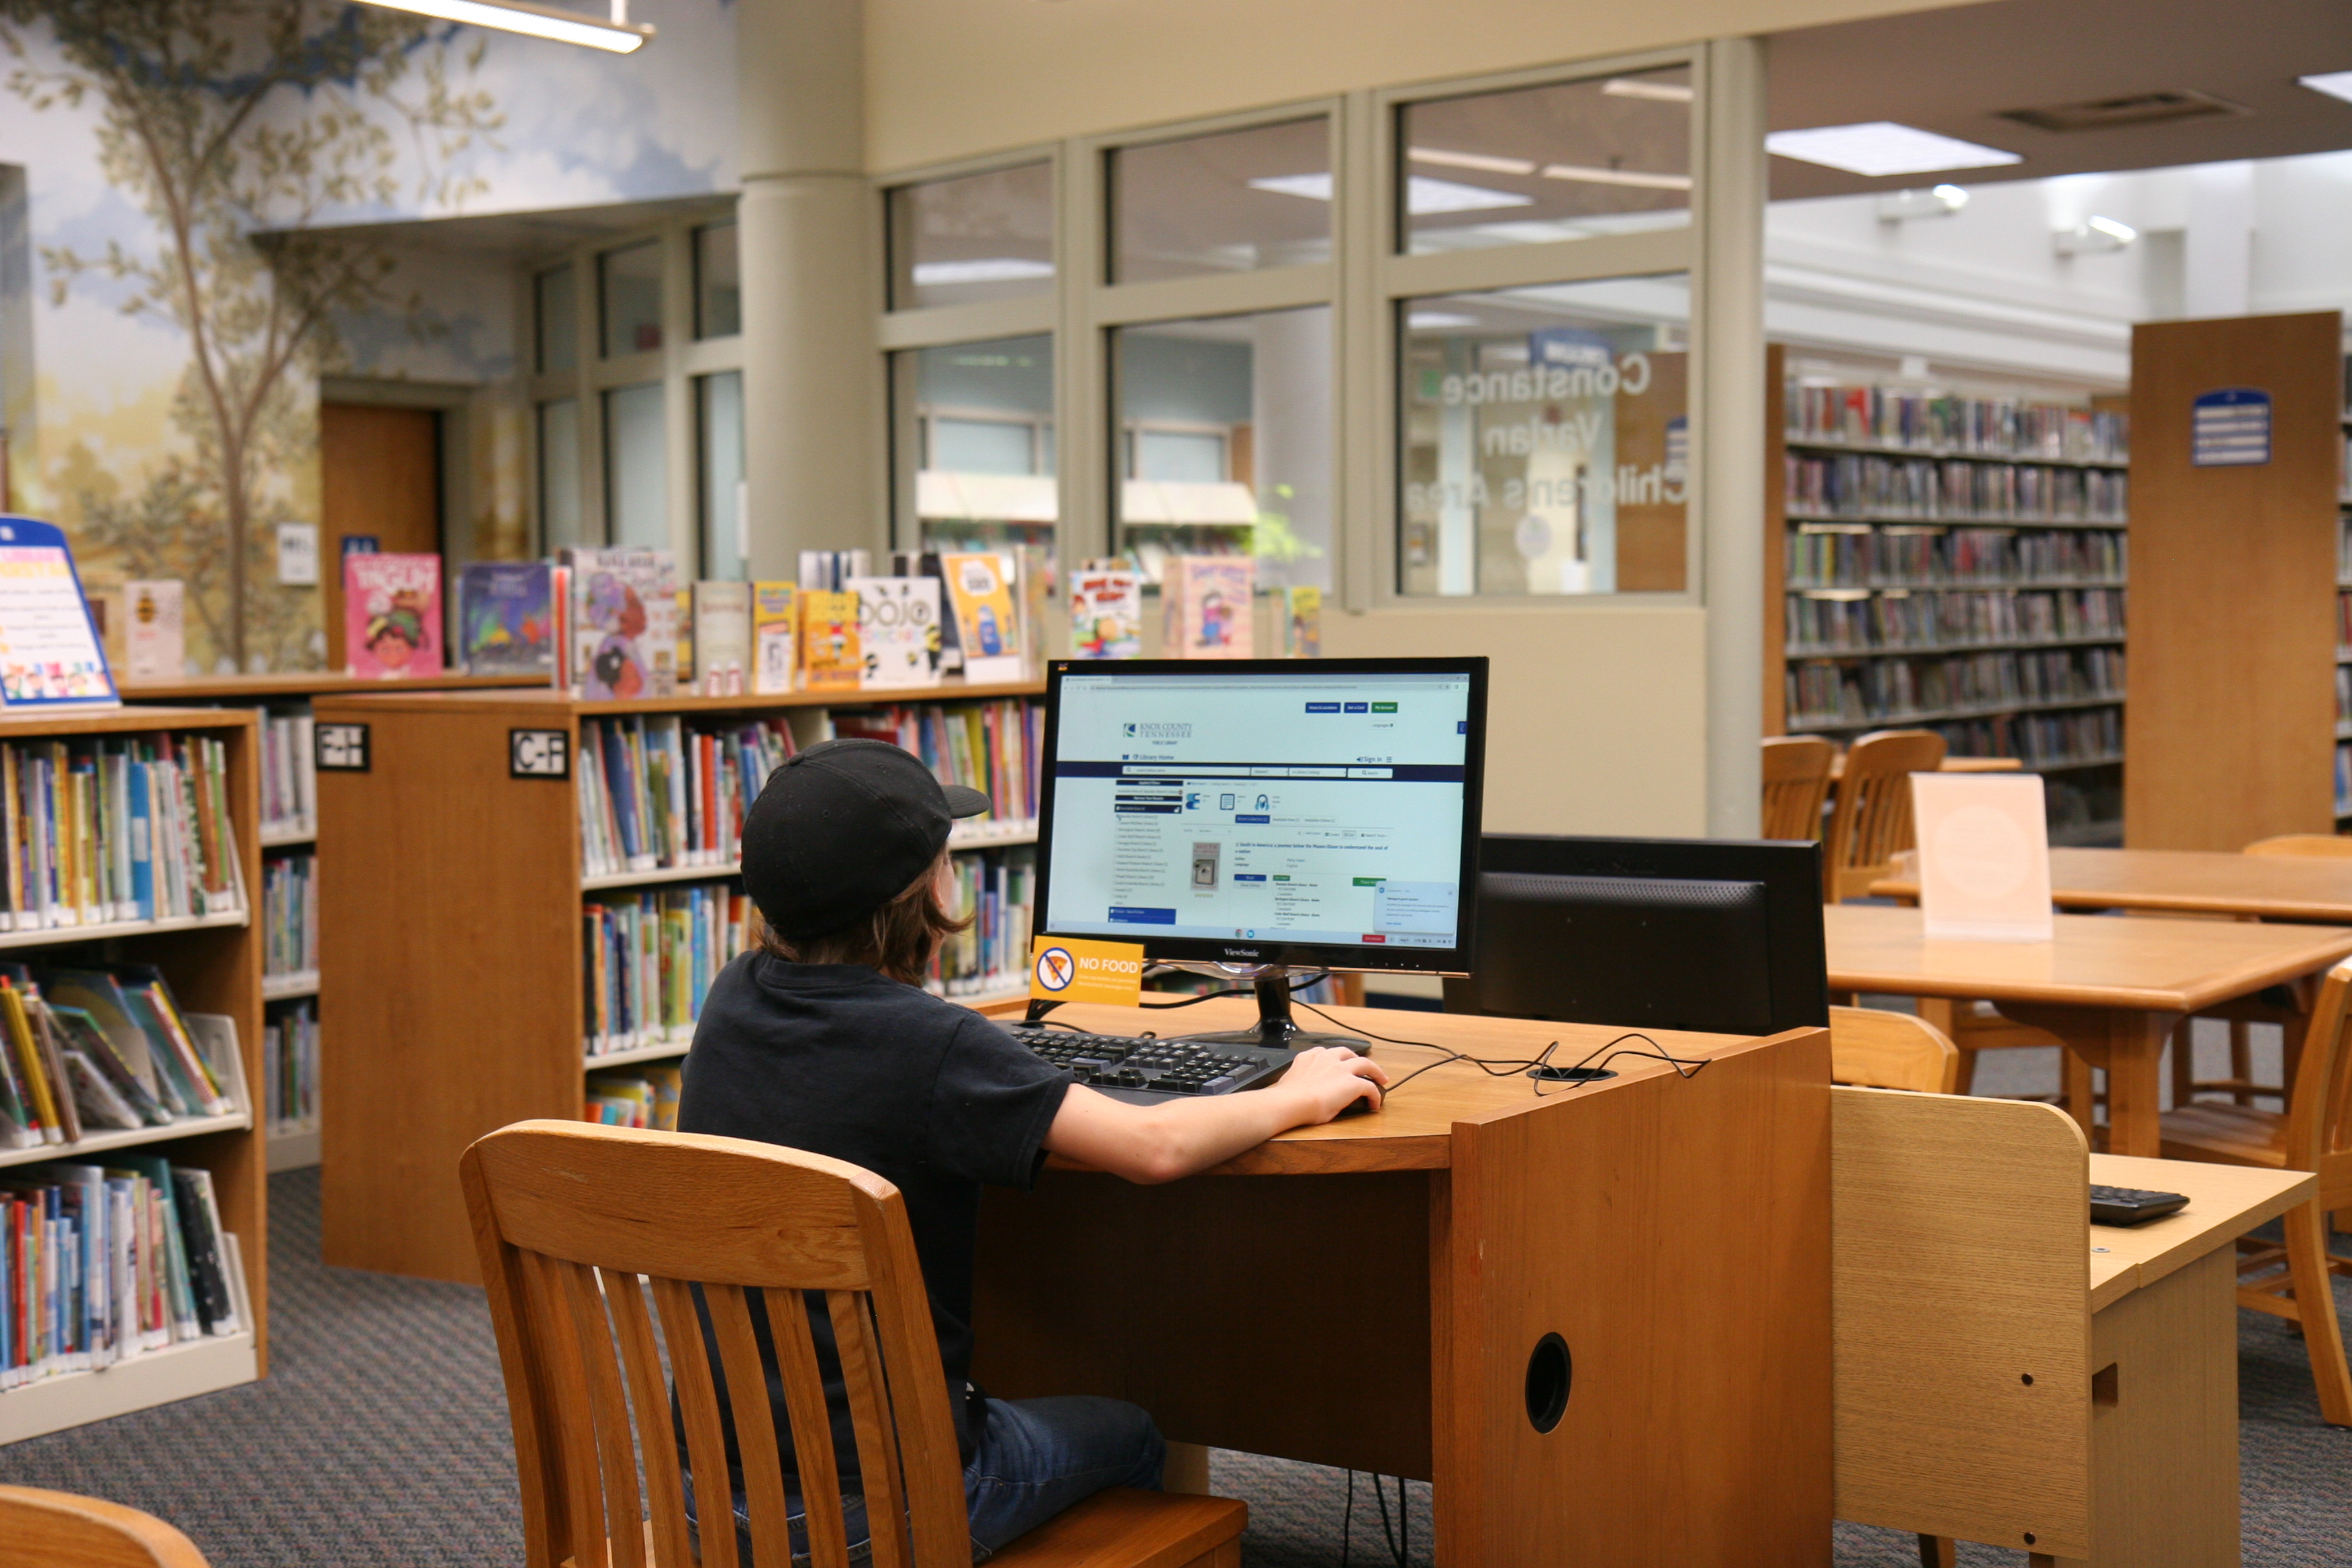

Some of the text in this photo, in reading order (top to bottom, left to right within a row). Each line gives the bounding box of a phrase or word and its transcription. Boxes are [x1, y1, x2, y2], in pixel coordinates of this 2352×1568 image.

[516, 734, 565, 771] C-F
[1224, 948, 1260, 957] ViewSonic
[1079, 958, 1138, 973] NO FOOD
